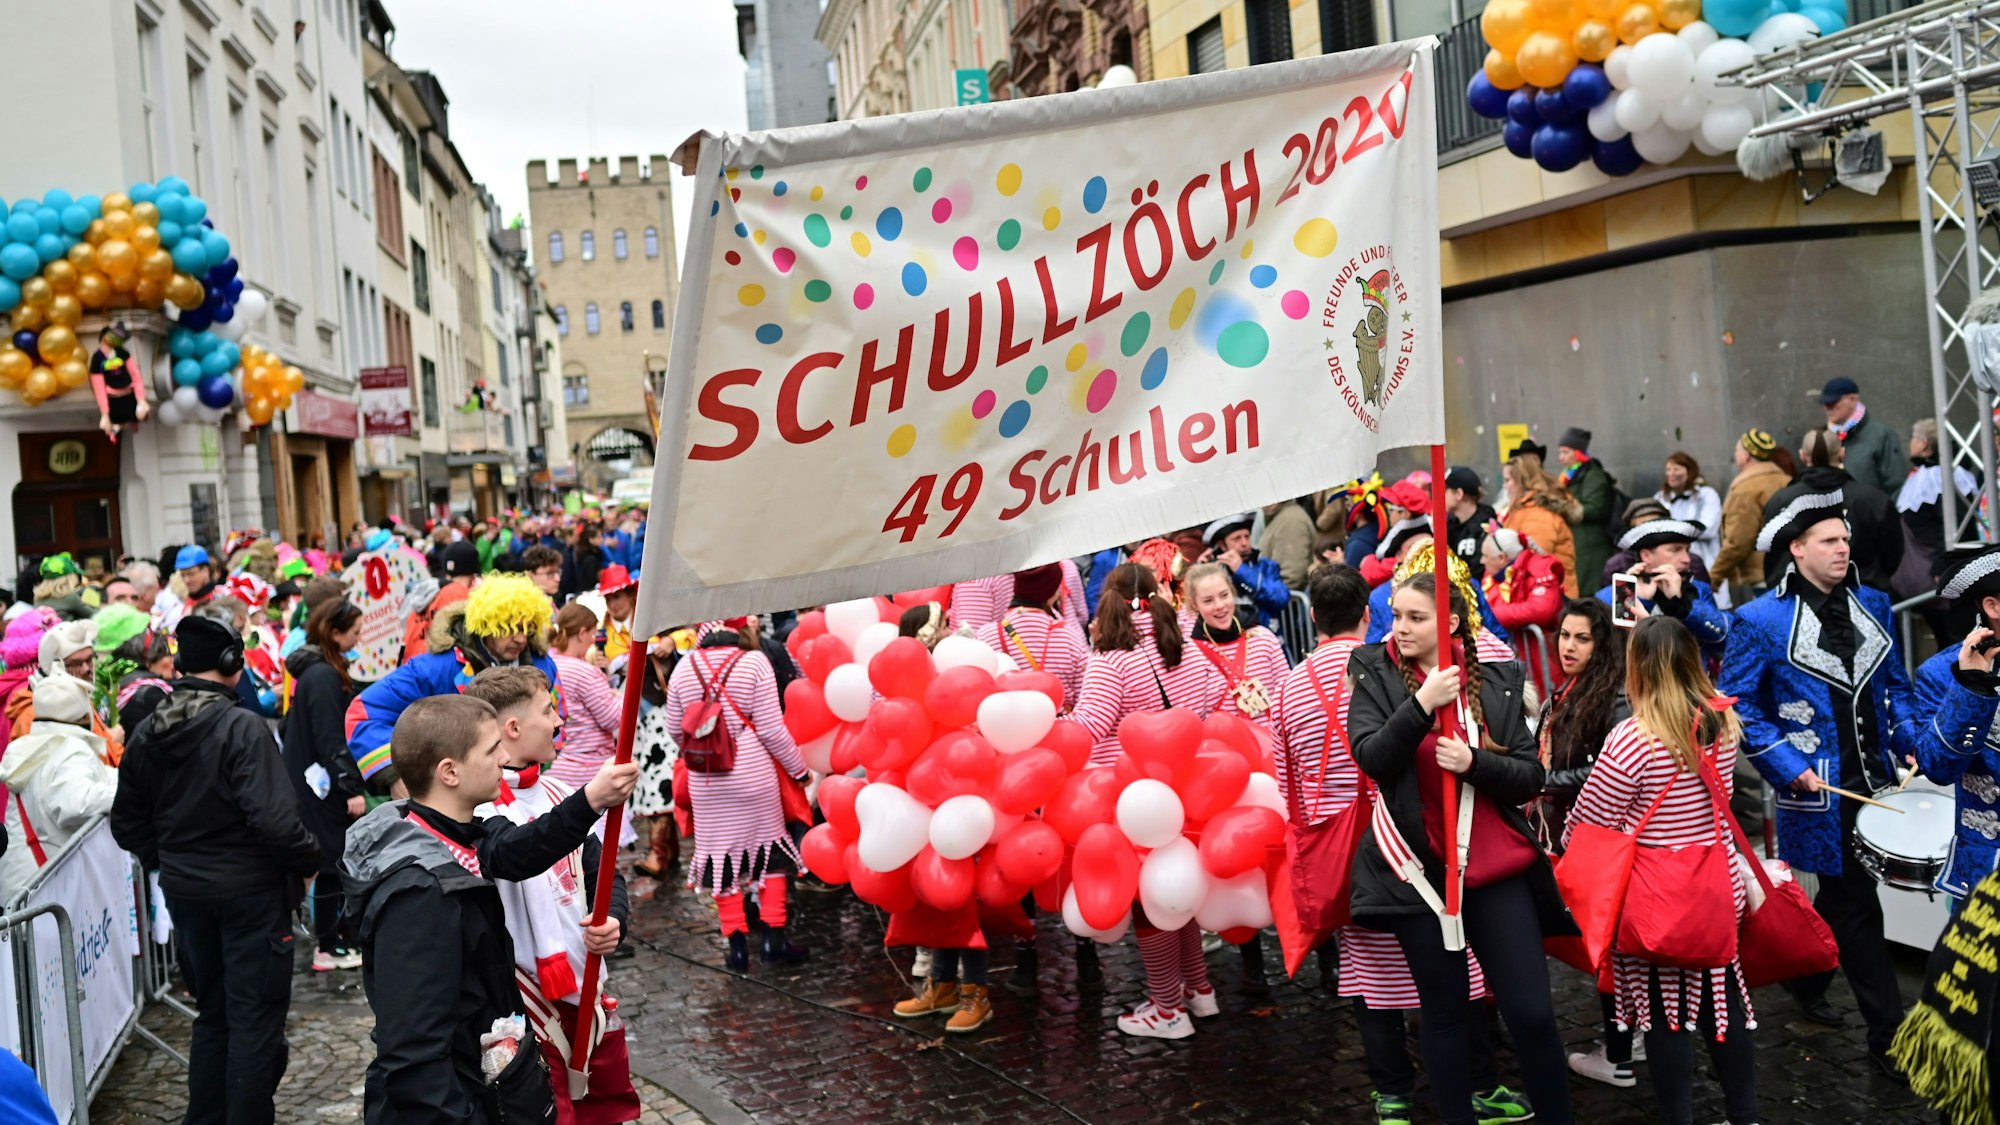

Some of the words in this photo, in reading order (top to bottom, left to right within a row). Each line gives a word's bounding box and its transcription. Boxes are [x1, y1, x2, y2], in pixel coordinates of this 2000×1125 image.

[687, 149, 1261, 463] SCHULLZÖCH
[1275, 70, 1413, 208] 2020
[1323, 258, 1360, 328] FREUNDE
[1361, 245, 1385, 264] UND
[1328, 355, 1347, 387] DES
[1400, 328, 1414, 353] E.V.
[883, 461, 984, 544] 49
[999, 399, 1261, 521] Schulen
